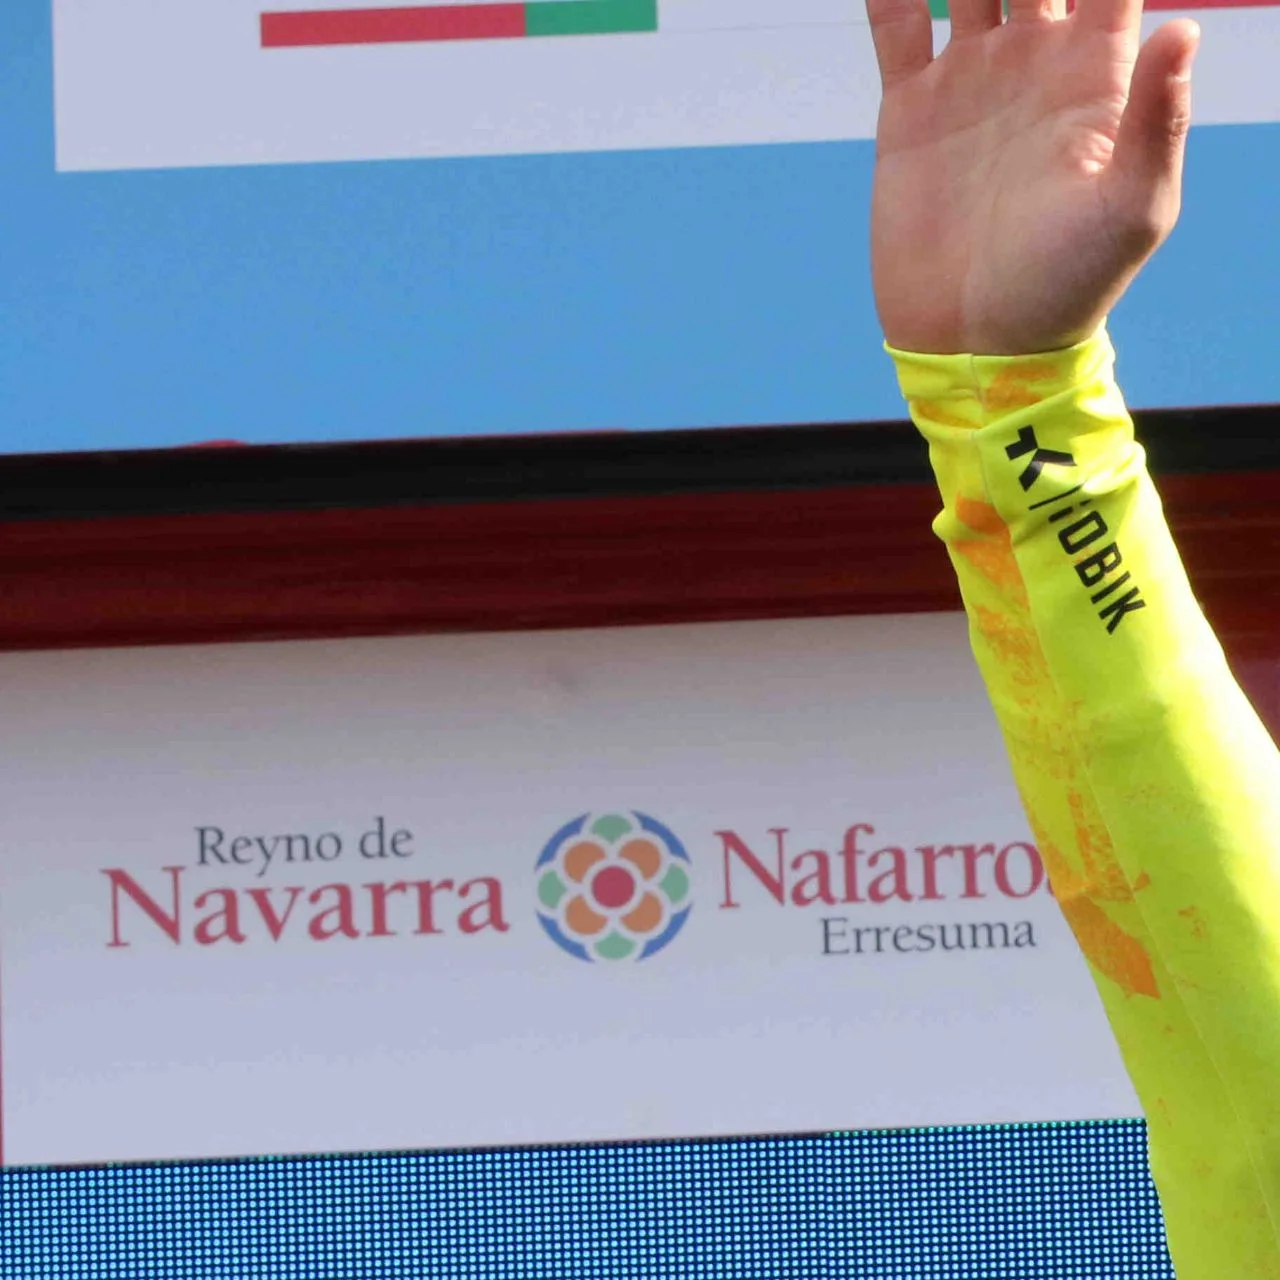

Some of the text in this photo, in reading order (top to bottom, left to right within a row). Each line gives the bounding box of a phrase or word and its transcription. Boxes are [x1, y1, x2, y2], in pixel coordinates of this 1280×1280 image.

[196, 816, 415, 869] Reyno de
[714, 822, 1057, 909] Nafarro
[100, 864, 511, 948] Navarra
[820, 916, 1037, 957] Erresuma
